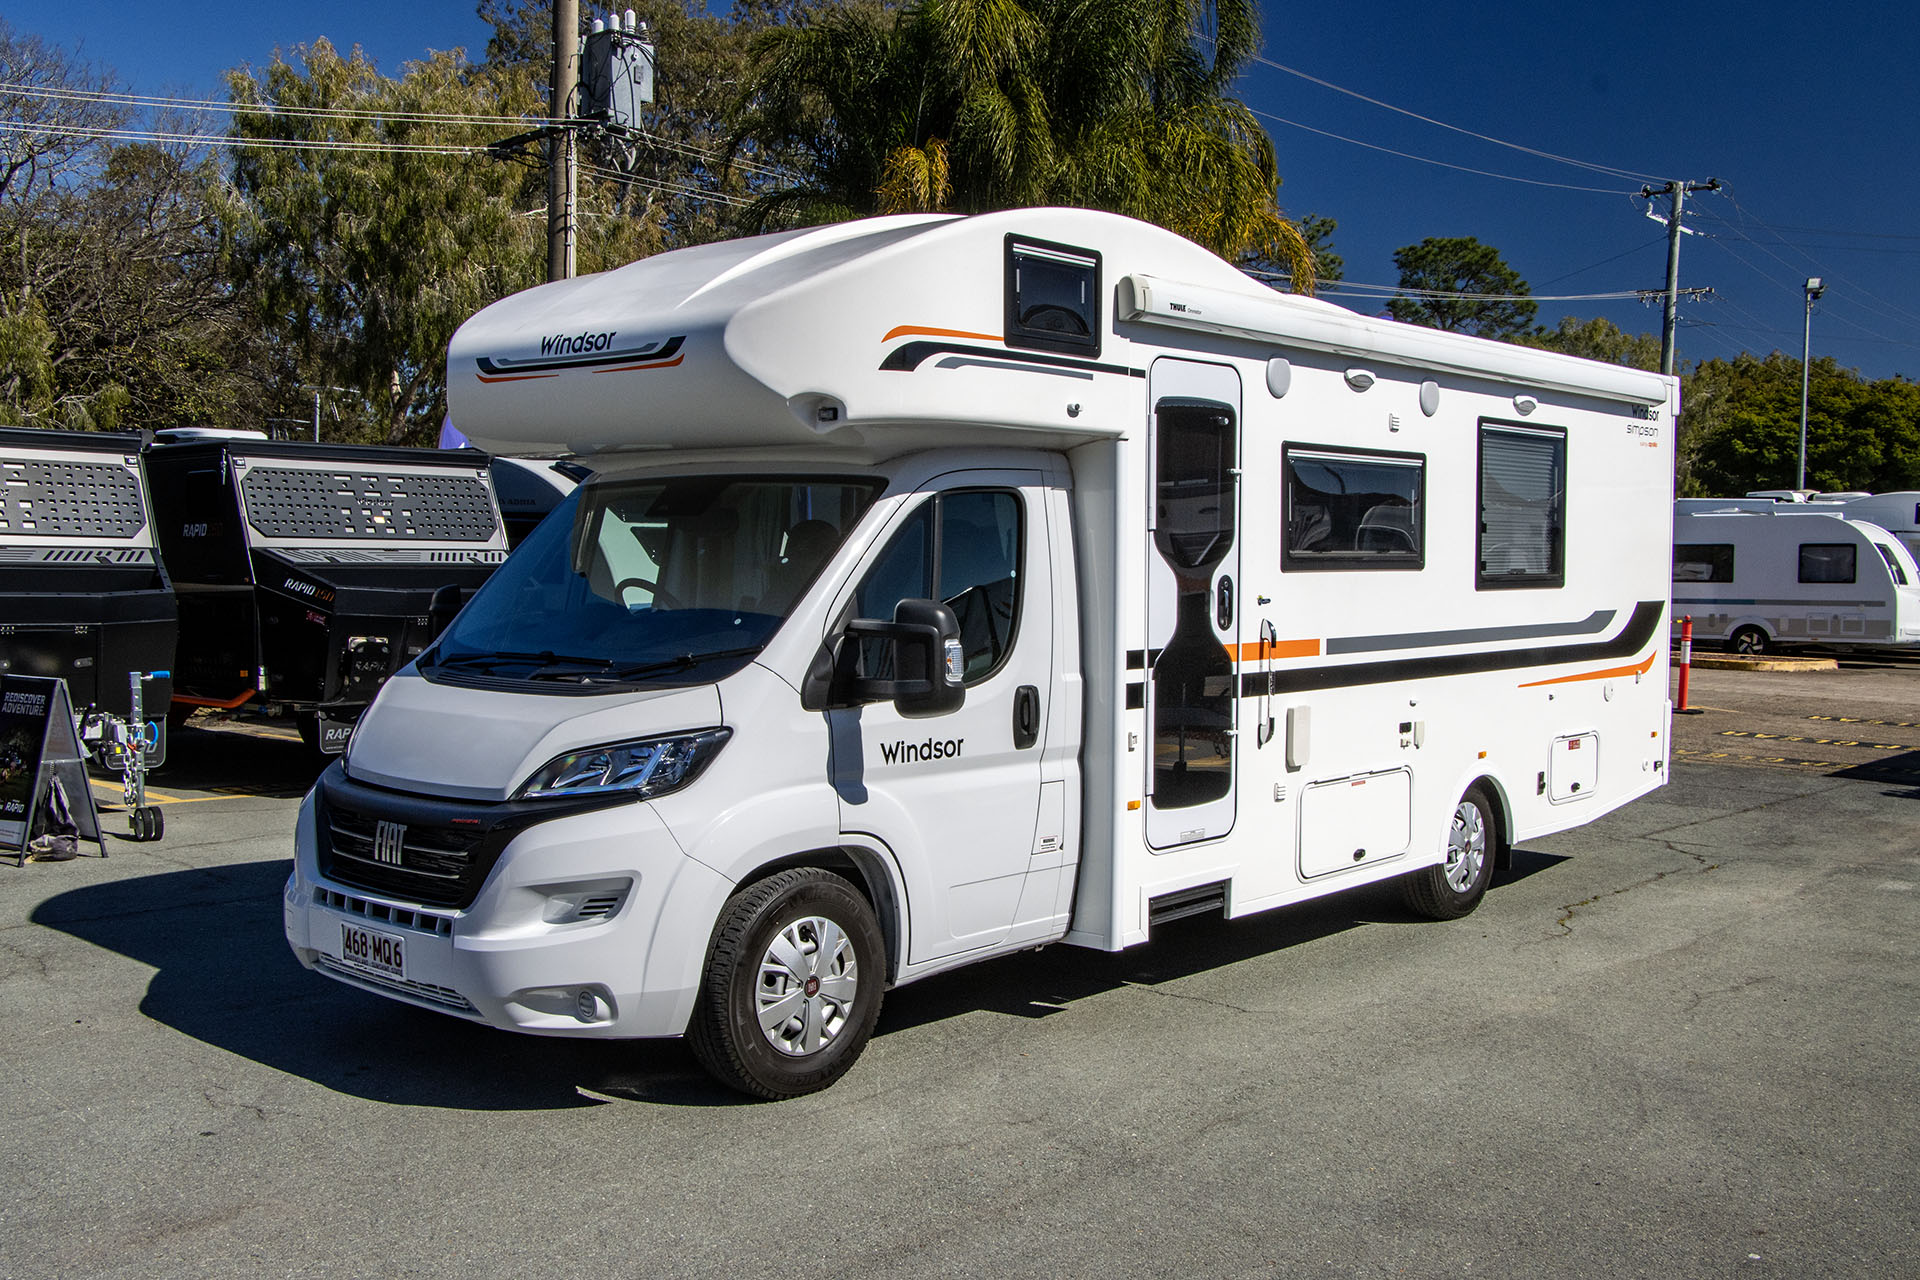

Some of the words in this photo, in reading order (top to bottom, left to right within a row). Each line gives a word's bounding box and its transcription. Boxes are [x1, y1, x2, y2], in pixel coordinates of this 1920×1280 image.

[1169, 302, 1187, 313] THULE
[541, 331, 617, 357] Windsor
[1631, 404, 1659, 421] Windsor
[1626, 424, 1659, 437] simpson
[183, 523, 208, 537] RAPID
[284, 578, 316, 595] RAPID
[4, 691, 46, 705] REDISCOVER
[325, 727, 353, 741] RAP
[880, 737, 965, 766] Windsor
[374, 820, 408, 865] FIAT
